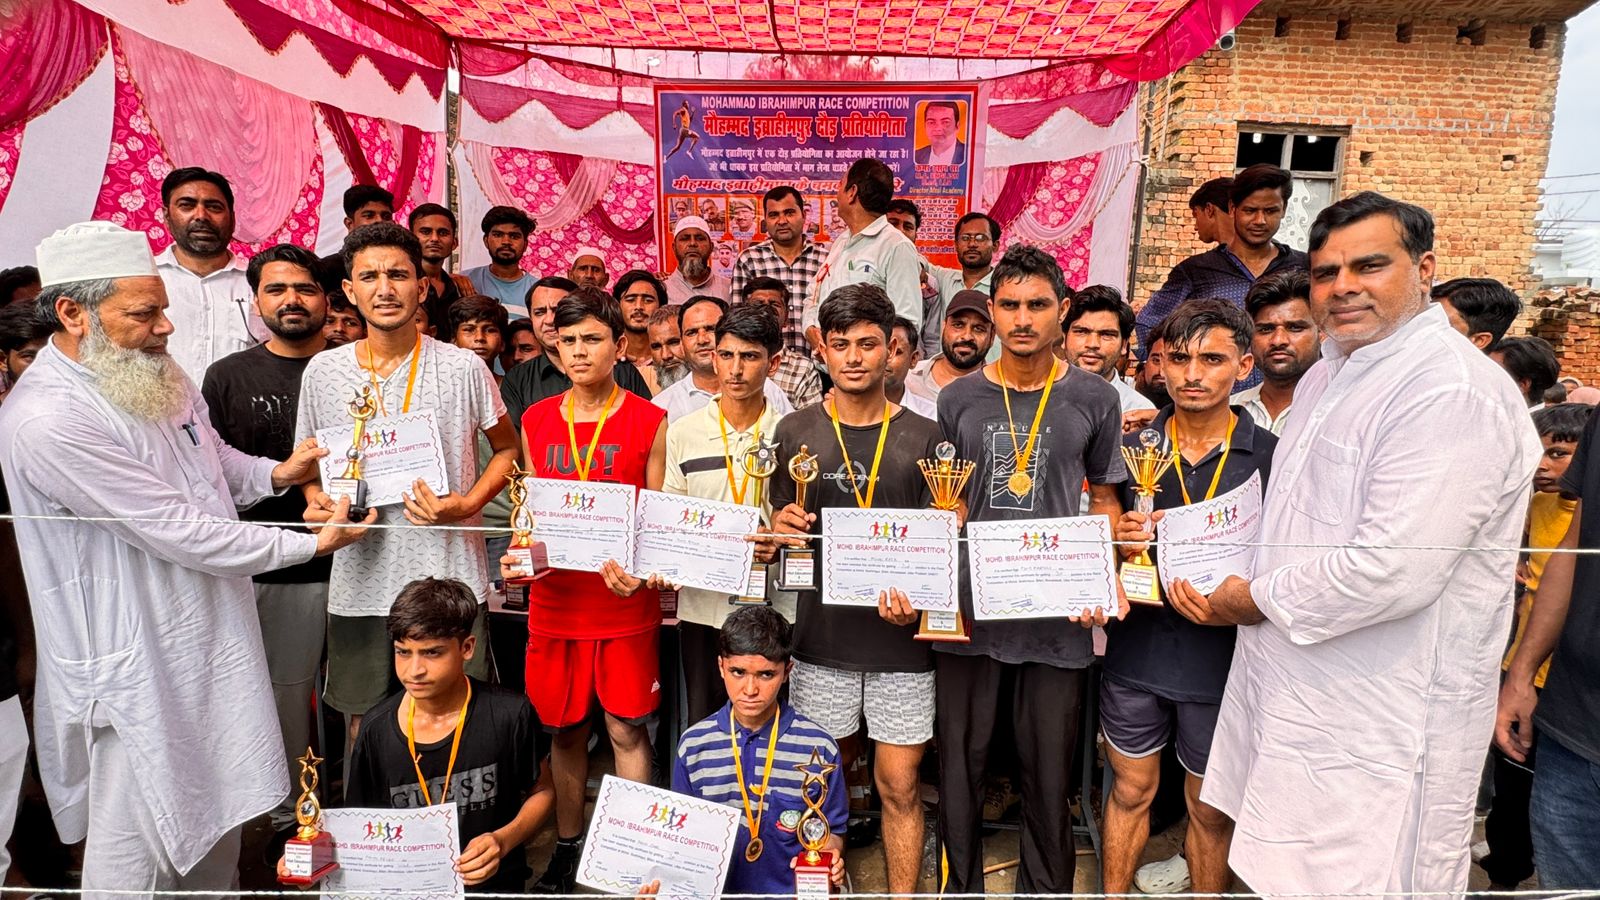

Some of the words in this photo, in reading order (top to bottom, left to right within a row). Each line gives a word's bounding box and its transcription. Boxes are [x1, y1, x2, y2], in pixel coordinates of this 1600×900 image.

[701, 96, 756, 109] MOHAMMAD
[758, 97, 816, 109] IBRAHIMPUR
[818, 97, 843, 109] RACE
[845, 97, 910, 109] COMPETITION
[703, 110, 750, 137] मौहम्मद
[752, 111, 813, 144] इब्राहीमपुर
[815, 111, 839, 142] दौड़
[841, 111, 907, 138] प्रतियोगिता
[672, 175, 724, 192] मौहम्मद
[987, 425, 1051, 433] NAUE
[399, 442, 431, 454] COMPETITION
[544, 444, 621, 476] JUST
[548, 511, 579, 520] IBRAHIMPUR
[579, 513, 592, 521] RACE
[593, 515, 624, 524] COMPETITION
[709, 533, 745, 544] COMPETITION
[855, 544, 889, 552] IBRAHIMPUR
[906, 546, 945, 554] COMPETITION
[1005, 554, 1041, 562] IBRAHIMPUR
[1059, 552, 1100, 560] COMPETITION
[626, 822, 662, 837] IBRAHIMPUR
[662, 832, 679, 843] RACE
[679, 836, 720, 853] COMPETITION
[350, 842, 385, 851] IBRAHIMPUR
[385, 844, 401, 852] RACE
[402, 841, 445, 852] COMPETITION
